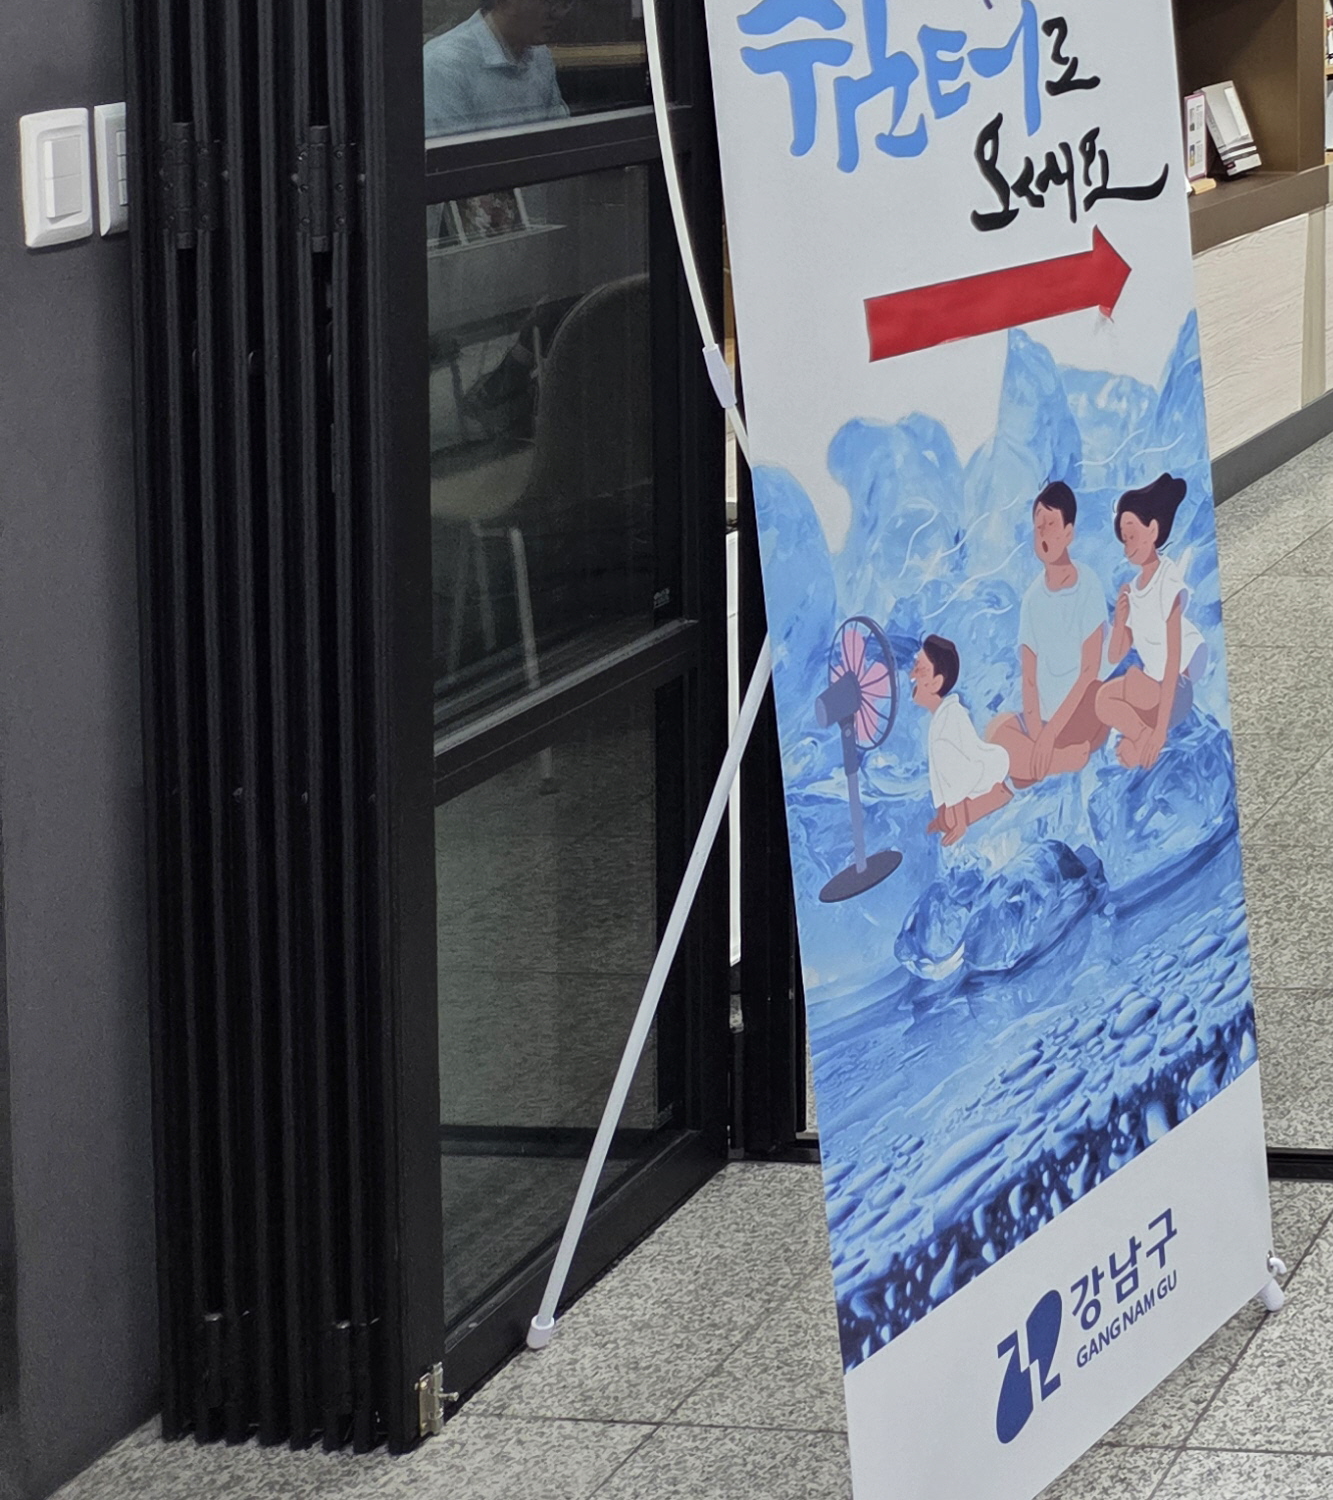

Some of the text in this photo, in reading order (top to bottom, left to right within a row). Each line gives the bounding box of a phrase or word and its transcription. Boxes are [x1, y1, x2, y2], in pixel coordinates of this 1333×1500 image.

[970, 111, 1170, 233] 오세요
[1070, 1207, 1178, 1331] 강남구
[1076, 1269, 1178, 1368] GANG NAM GU
